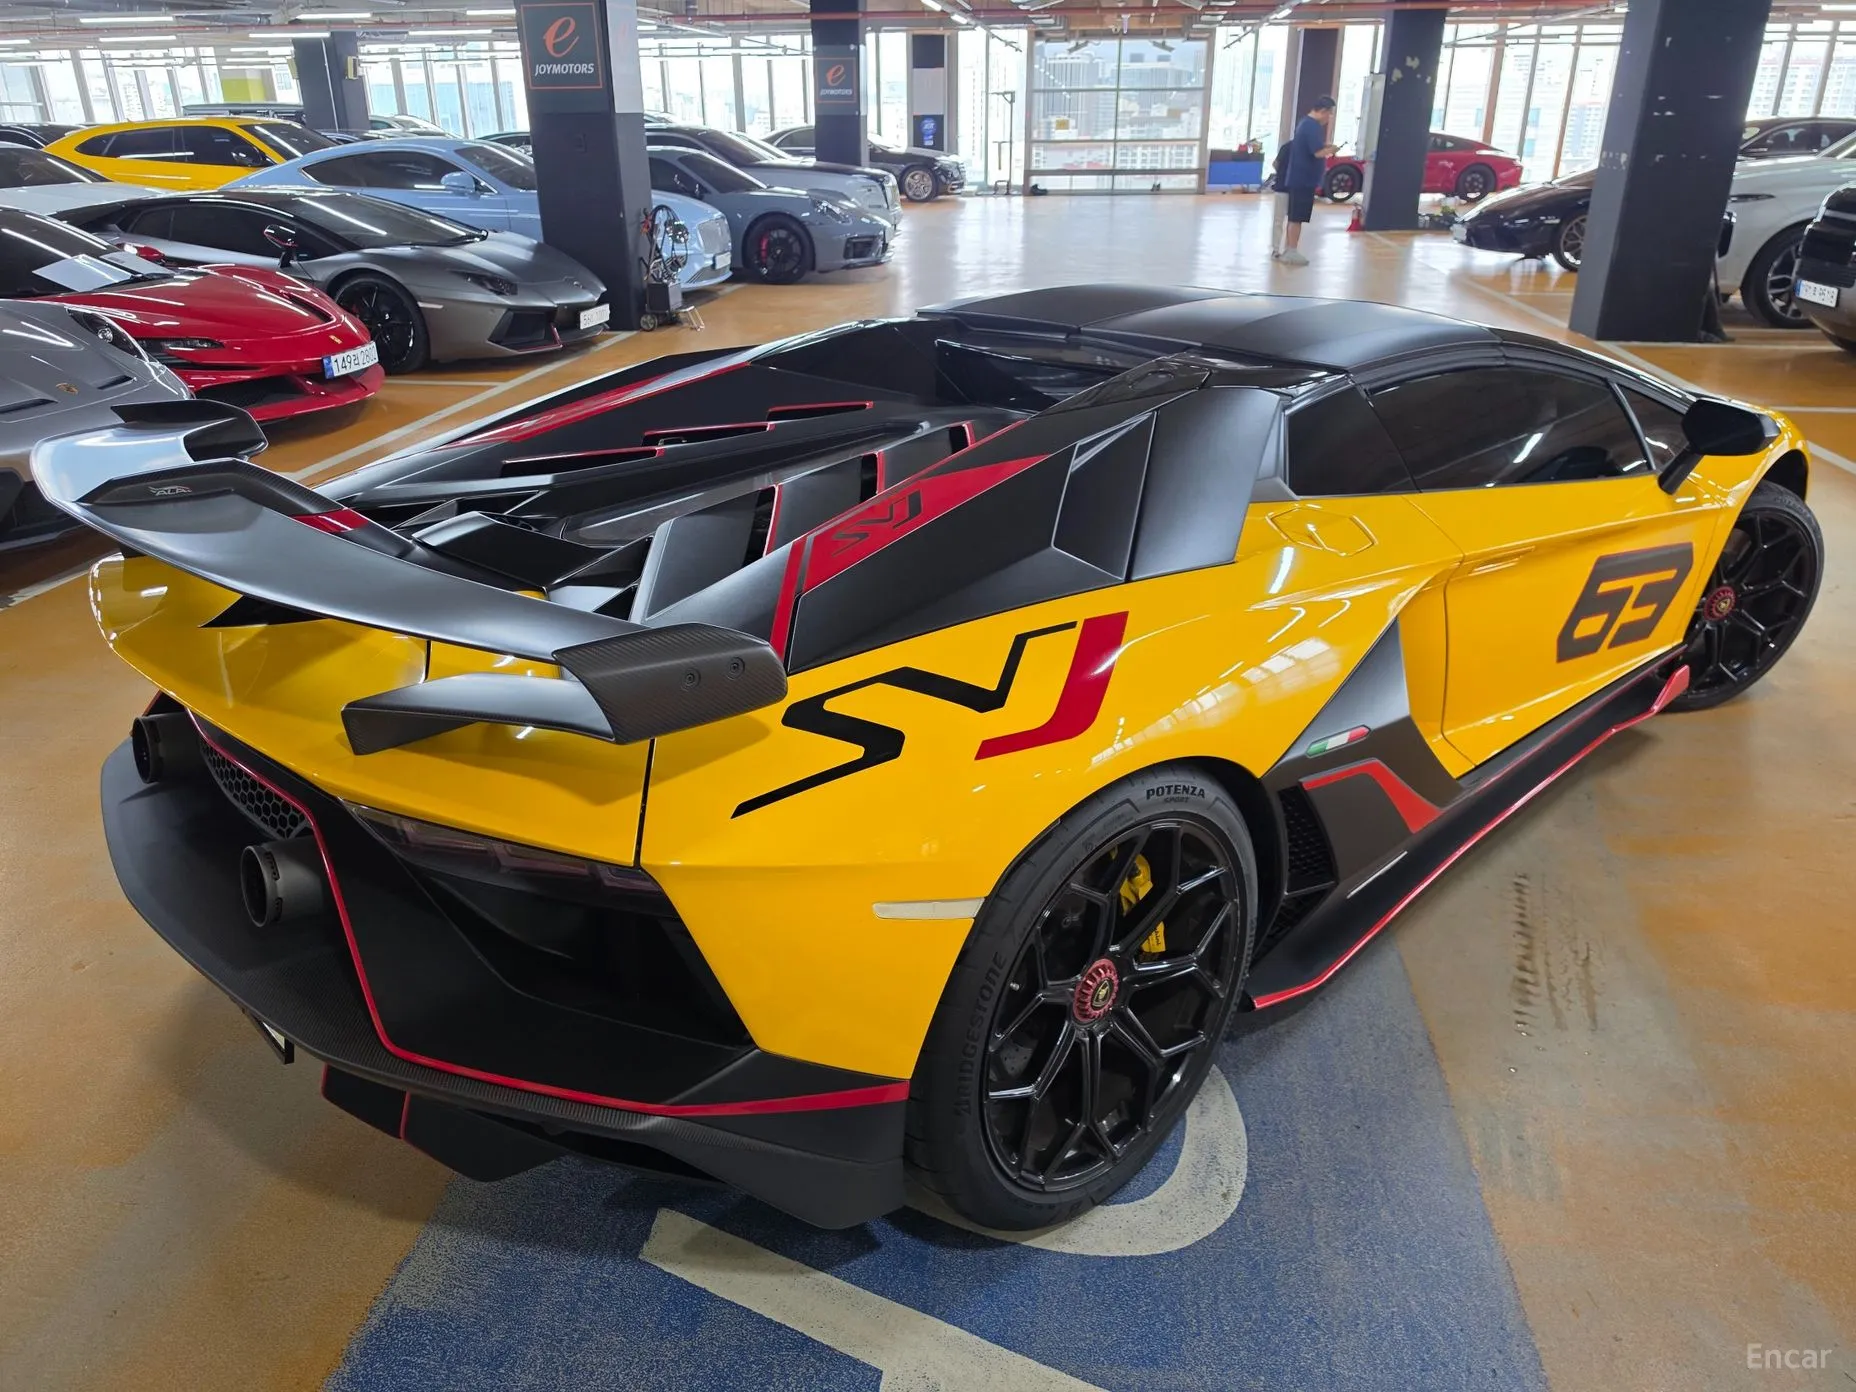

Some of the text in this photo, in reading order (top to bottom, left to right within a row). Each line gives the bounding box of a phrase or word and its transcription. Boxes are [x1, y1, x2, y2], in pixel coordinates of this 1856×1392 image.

[543, 16, 579, 58] e
[535, 63, 595, 77] JOYMOTORS
[826, 64, 846, 87] e
[831, 488, 923, 558] SVJ
[1556, 541, 1694, 664] 63
[730, 611, 1130, 819] SVJ
[1146, 784, 1206, 800] POTENZA
[953, 951, 1007, 1117] BRIDGESTONE
